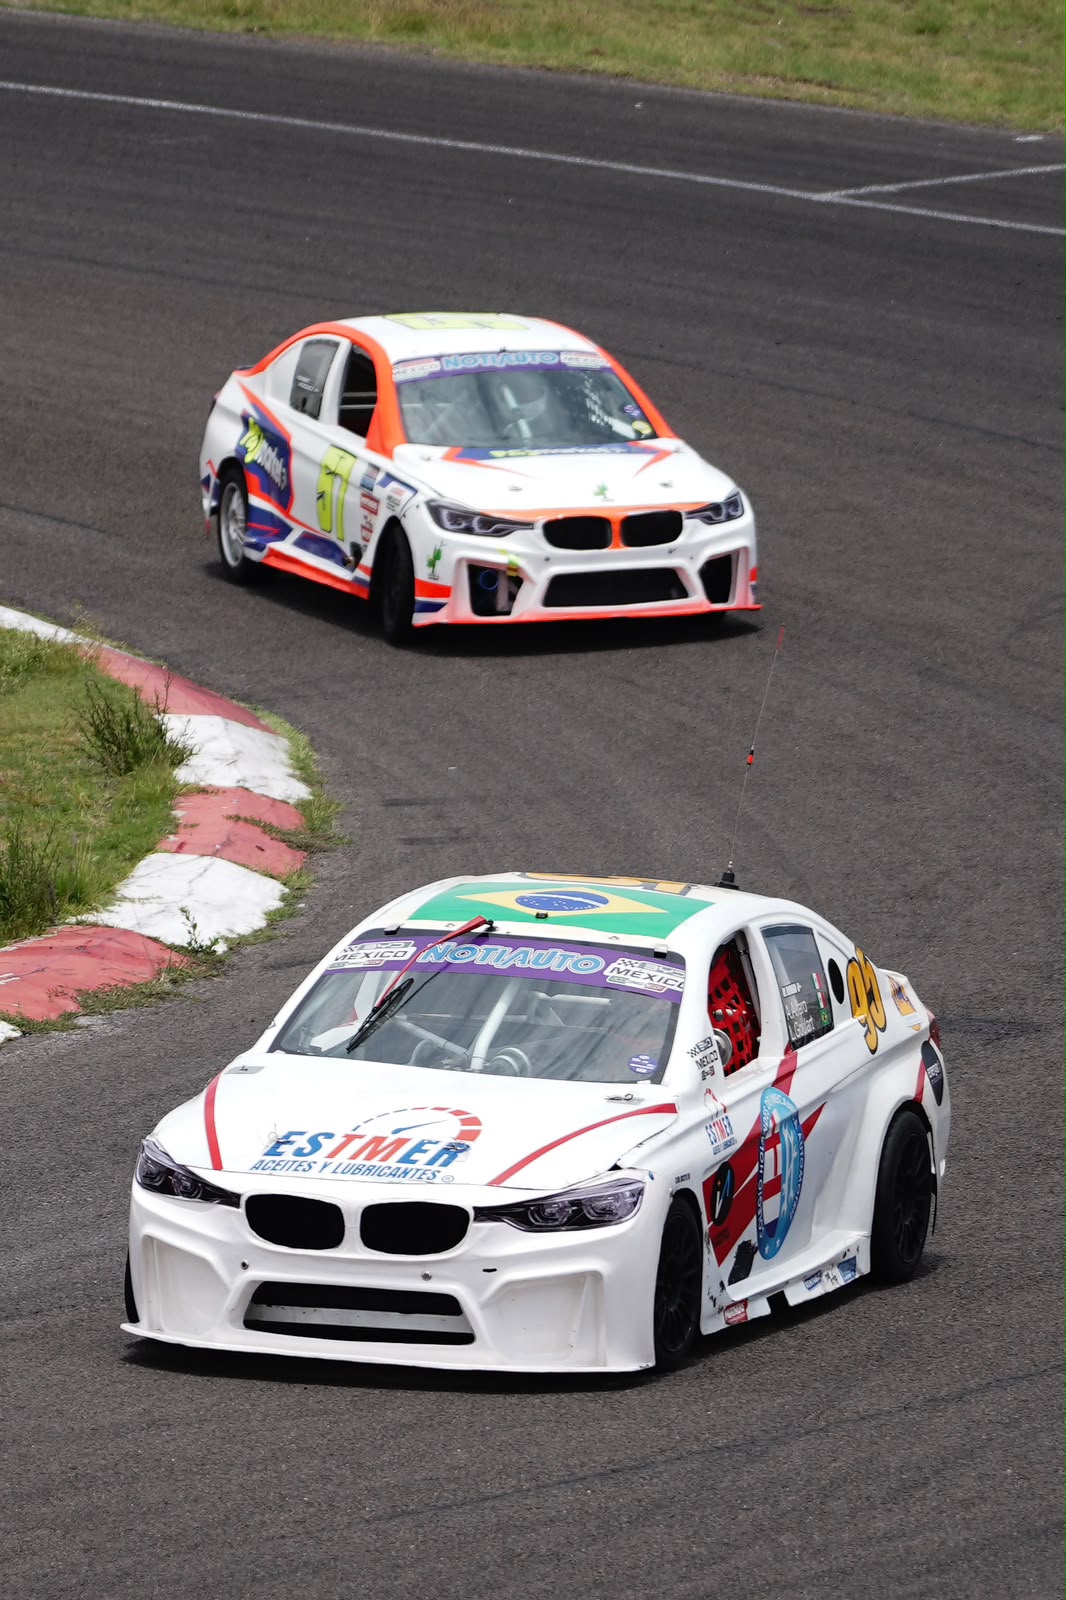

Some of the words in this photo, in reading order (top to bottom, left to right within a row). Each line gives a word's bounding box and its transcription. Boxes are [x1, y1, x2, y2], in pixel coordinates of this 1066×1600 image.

[443, 352, 559, 370] NOTIAUTO
[419, 943, 603, 974] NOTIAUTO
[705, 1115, 734, 1146] ESTMER
[262, 1131, 471, 1168] ESTMER
[250, 1159, 316, 1172] ACEITES
[319, 1161, 332, 1173] Y
[331, 1162, 442, 1181] LUBRICANTES
